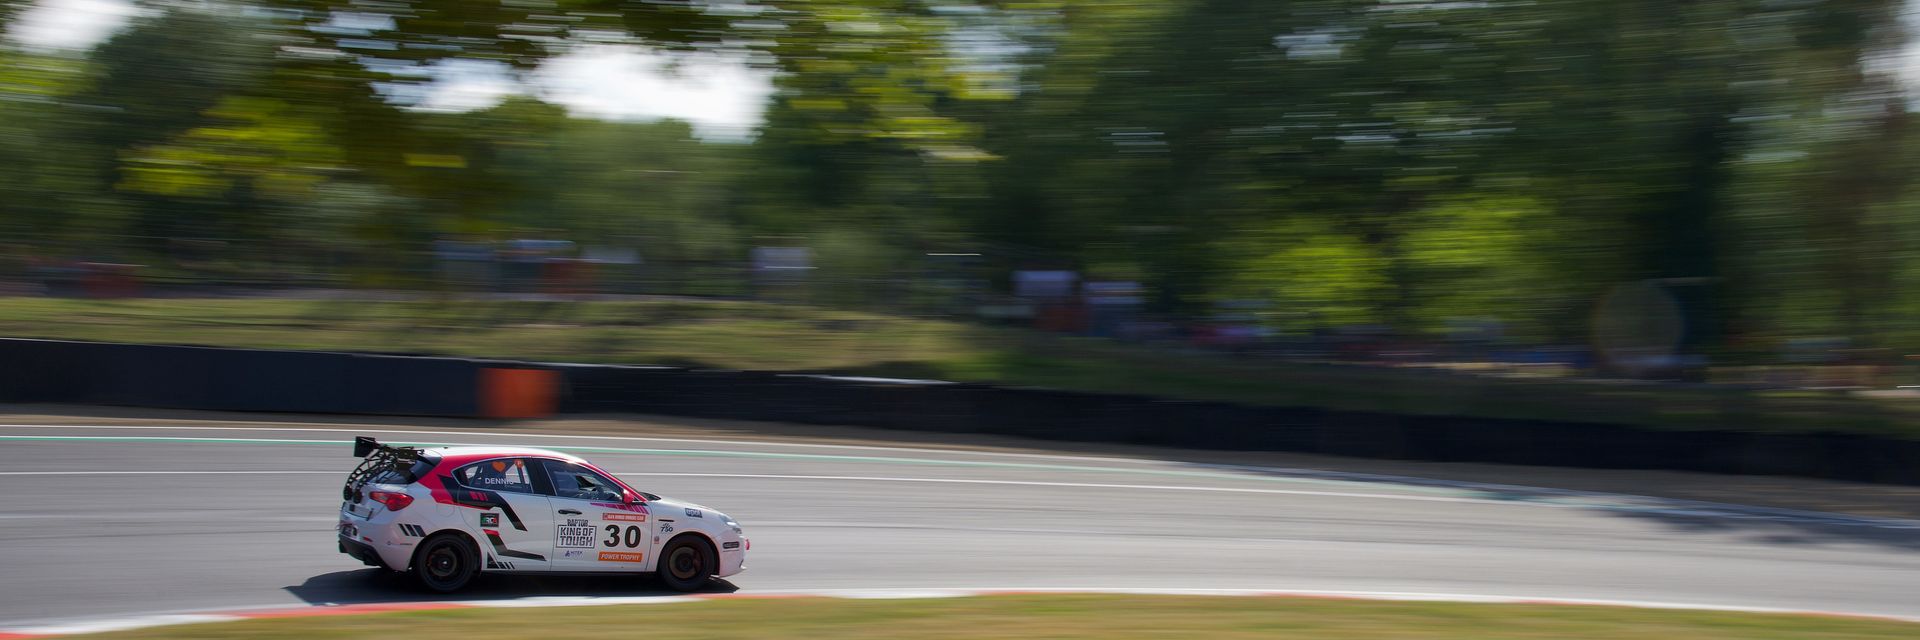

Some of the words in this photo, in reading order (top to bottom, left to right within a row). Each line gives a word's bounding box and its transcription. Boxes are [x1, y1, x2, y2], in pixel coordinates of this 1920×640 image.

[560, 527, 581, 536] KING
[582, 528, 594, 536] OF
[603, 524, 641, 548] 30
[560, 536, 593, 546] TOUGH
[620, 553, 640, 561] TROPHY
